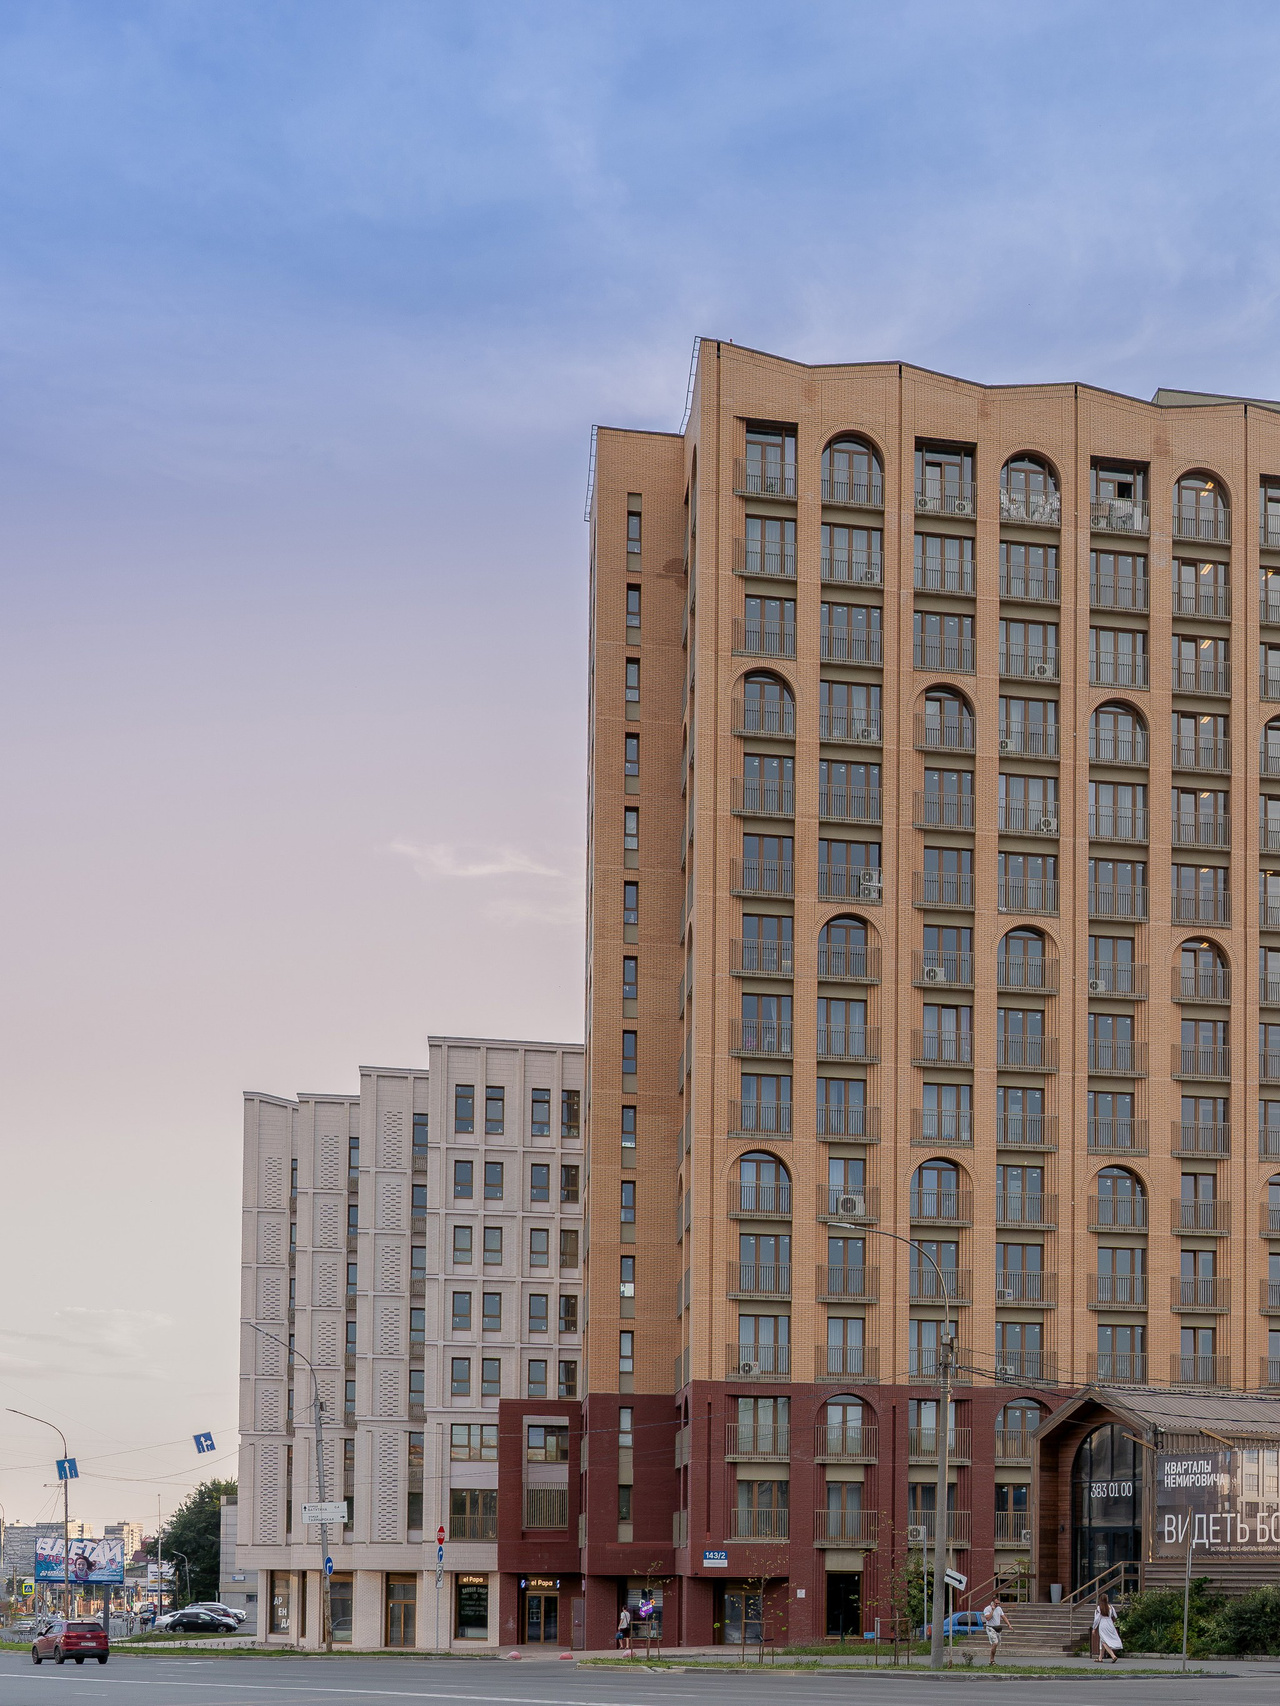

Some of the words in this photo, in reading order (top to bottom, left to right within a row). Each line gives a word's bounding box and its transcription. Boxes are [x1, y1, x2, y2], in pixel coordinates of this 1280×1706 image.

[1164, 1460, 1212, 1475] КВАРТАЛЫ
[1164, 1473, 1225, 1488] НЕМИРОВИЧА
[1090, 1483, 1107, 1497] 383
[1109, 1482, 1119, 1497] 01
[1120, 1482, 1133, 1497] 00
[1164, 1513, 1250, 1548] ВИДЕТЬ
[36, 1537, 124, 1564] ВЛЕТАЙ
[37, 1553, 44, 1561] В
[47, 1553, 75, 1565] ЛЕТО
[469, 1576, 484, 1584] Papa
[538, 1579, 553, 1587] Papa
[273, 1596, 283, 1605] АР
[278, 1607, 287, 1616] ЕН
